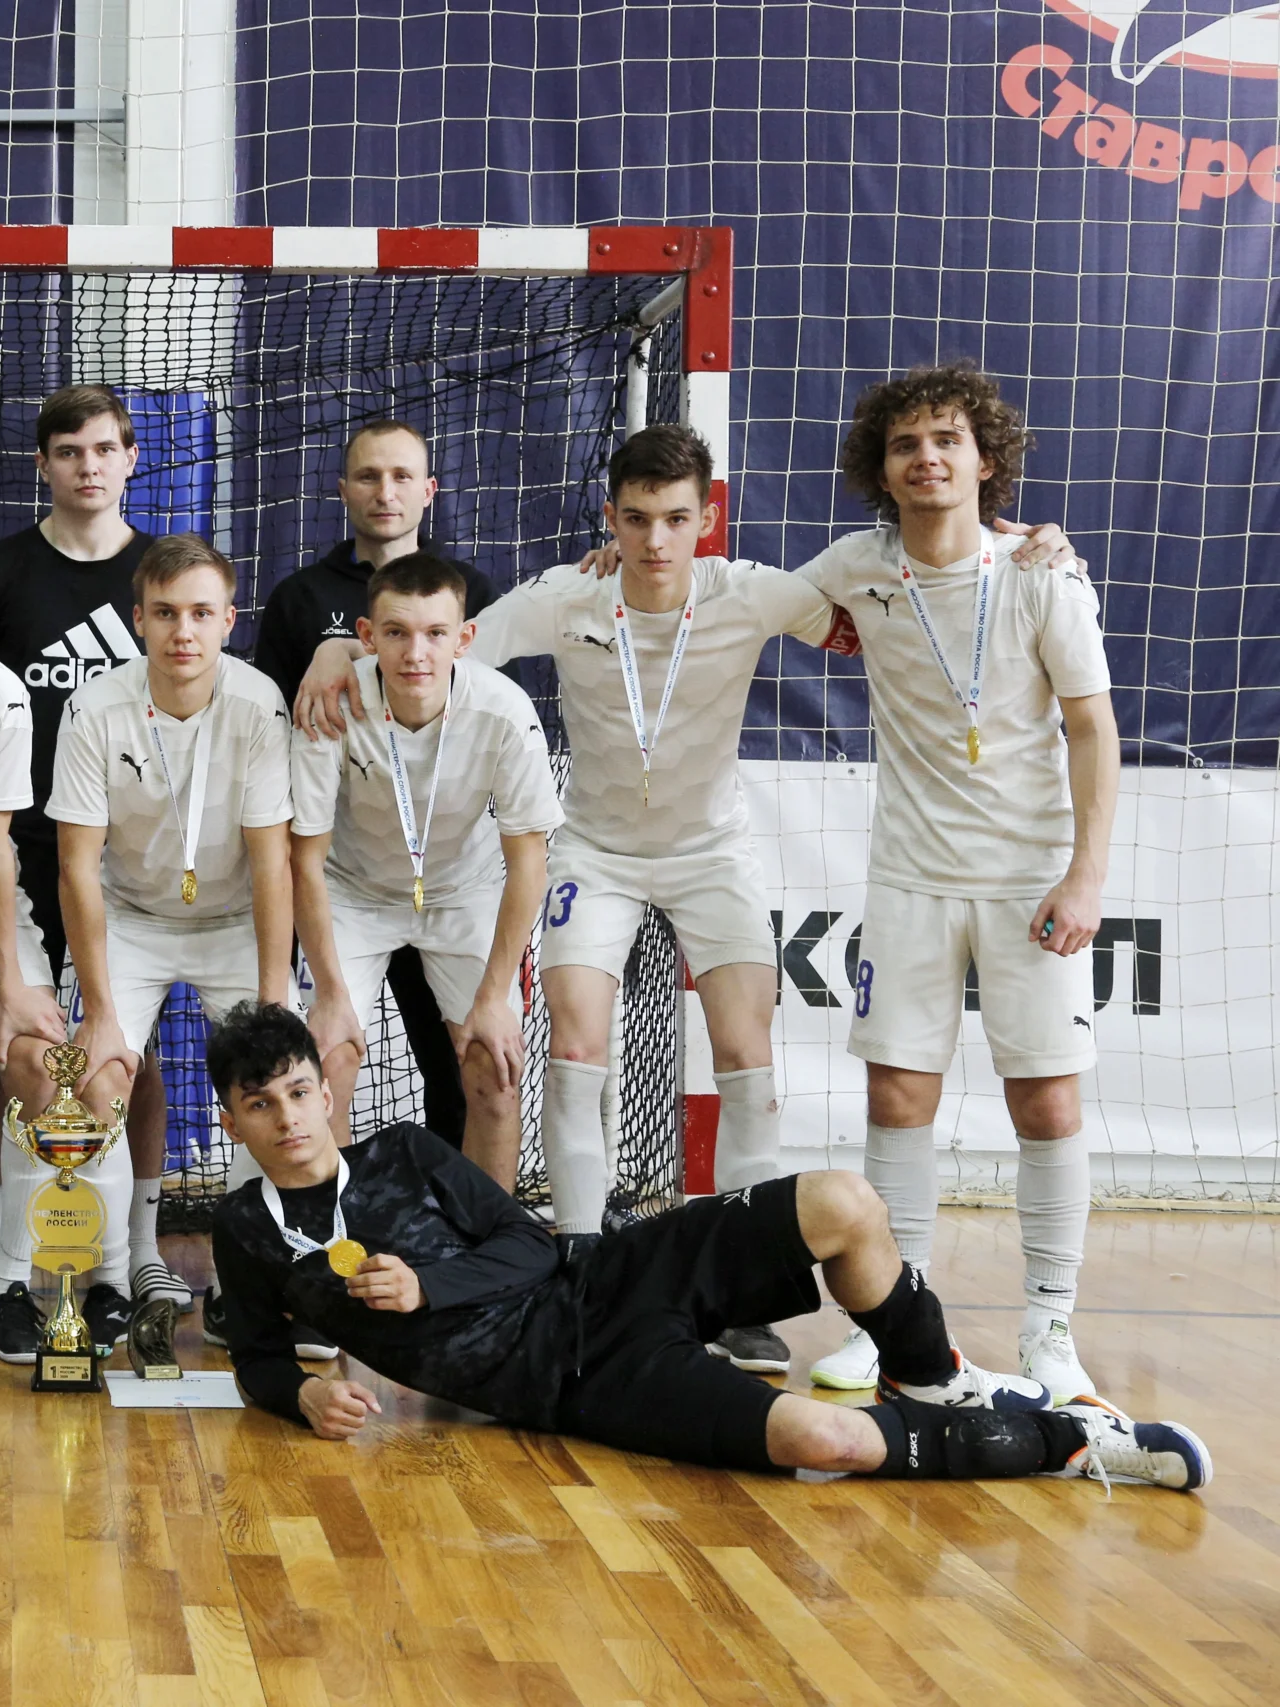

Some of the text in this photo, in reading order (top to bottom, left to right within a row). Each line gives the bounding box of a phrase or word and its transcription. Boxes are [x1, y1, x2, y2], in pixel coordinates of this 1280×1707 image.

[909, 588, 923, 614] РОССИИ
[919, 614, 933, 638] СПОРТА
[974, 575, 989, 681] МИНИСТЕРСТВО СПОРТА РОССИИ
[24, 658, 112, 689] adid
[620, 628, 642, 728] МИНИСТЕРСТВО СПОРТА РОССИИ
[389, 731, 413, 831] МИНИСТЕРСТВО СПОРТА РОССИИ
[856, 959, 874, 1018] 8
[34, 1209, 99, 1218] ПЕРВЕНСТВО
[46, 1219, 88, 1227] РОССИИ
[50, 1365, 57, 1379] 1
